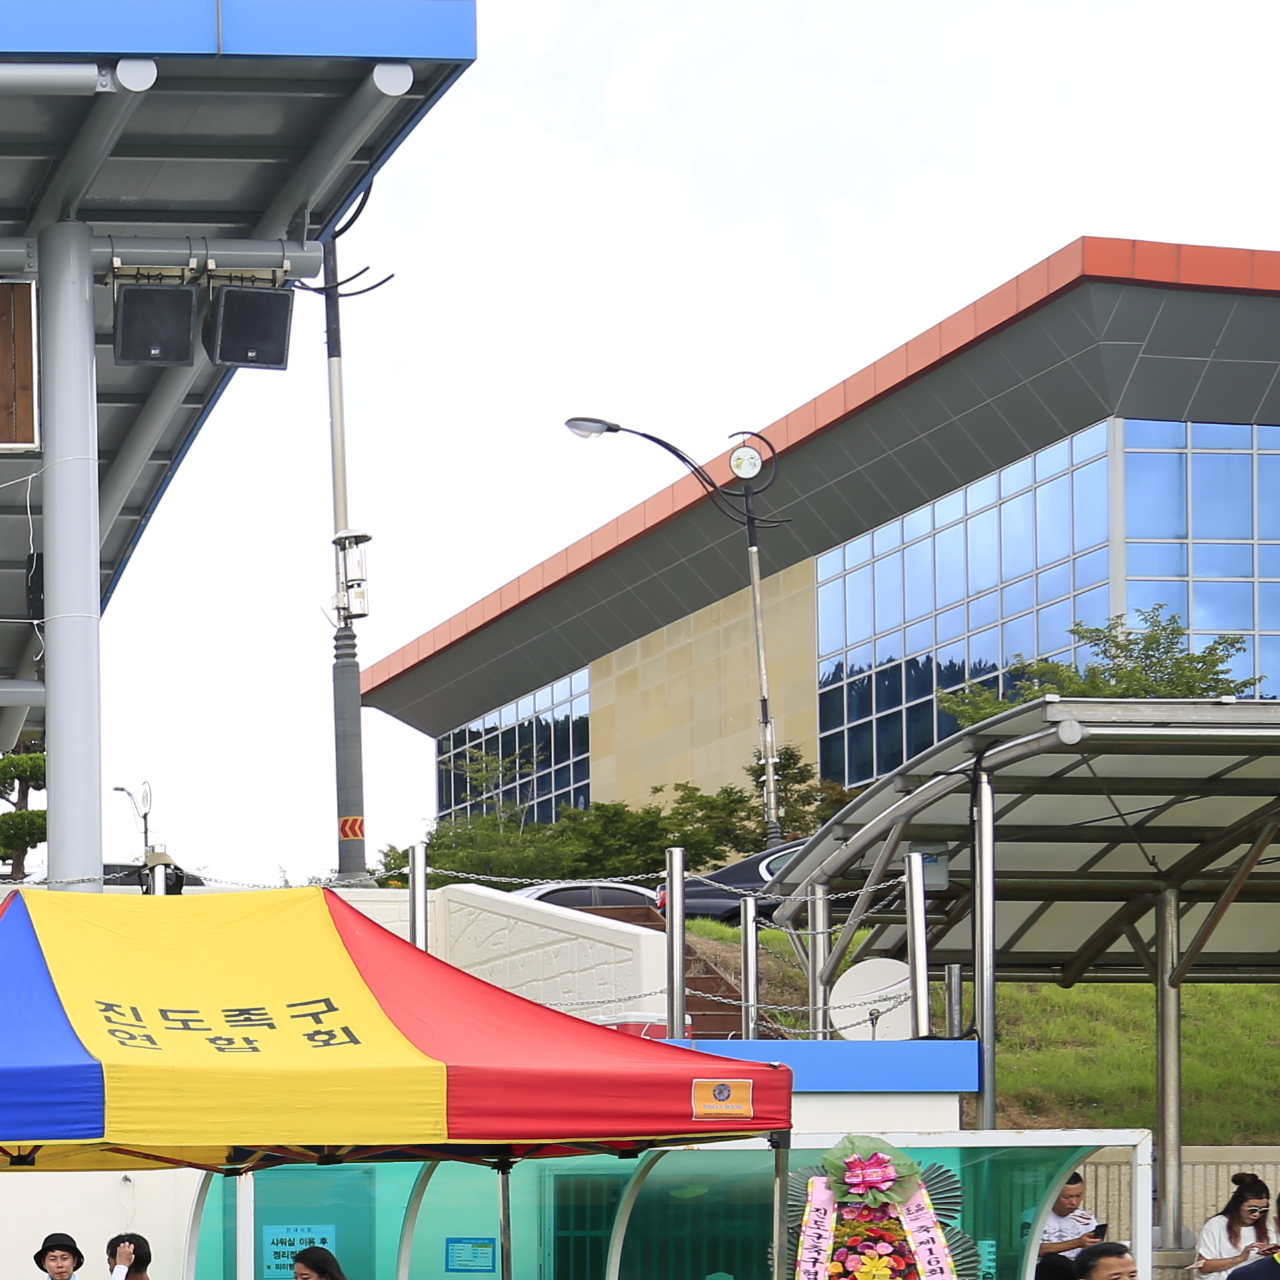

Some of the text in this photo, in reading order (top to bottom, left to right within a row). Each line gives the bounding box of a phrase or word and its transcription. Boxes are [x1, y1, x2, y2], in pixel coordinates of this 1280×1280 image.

[94, 997, 340, 1032] 진도족구
[106, 1025, 363, 1053] 연합회
[299, 1237, 316, 1246] 이용
[319, 1237, 328, 1246] 후
[273, 1250, 301, 1259] 정리정
